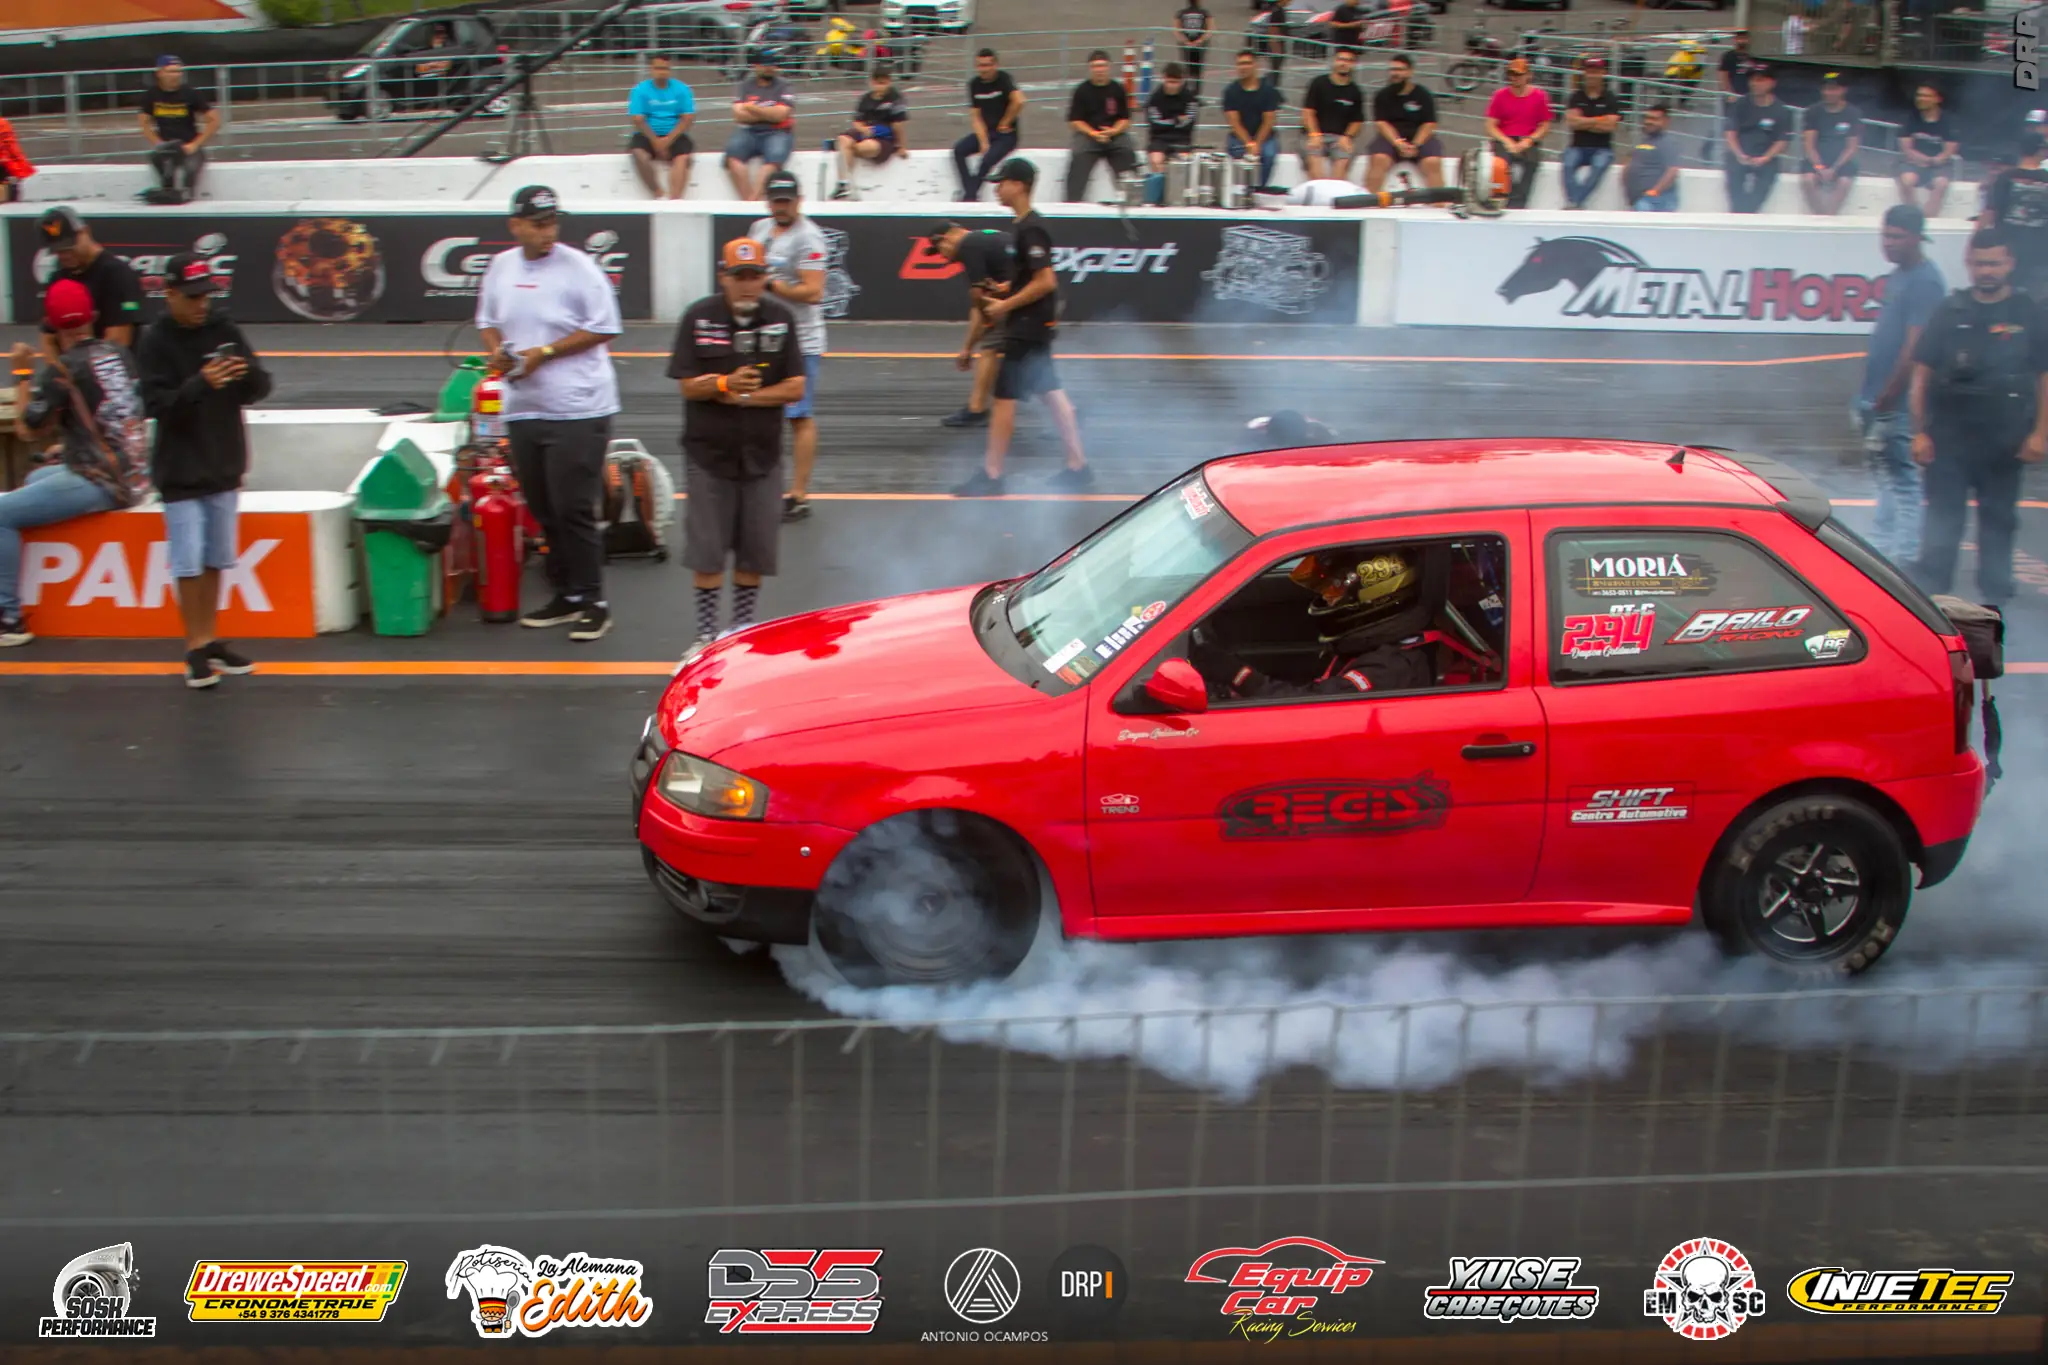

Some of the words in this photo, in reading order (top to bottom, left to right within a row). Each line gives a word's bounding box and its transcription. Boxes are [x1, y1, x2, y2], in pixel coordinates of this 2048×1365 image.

[1562, 263, 1888, 322] METALHORS
[1590, 554, 1688, 577] MORIÁ
[1561, 611, 1656, 654] 294
[1587, 787, 1674, 808] SHIFT
[1101, 805, 1139, 814] TREND
[1571, 811, 1615, 821] Centro
